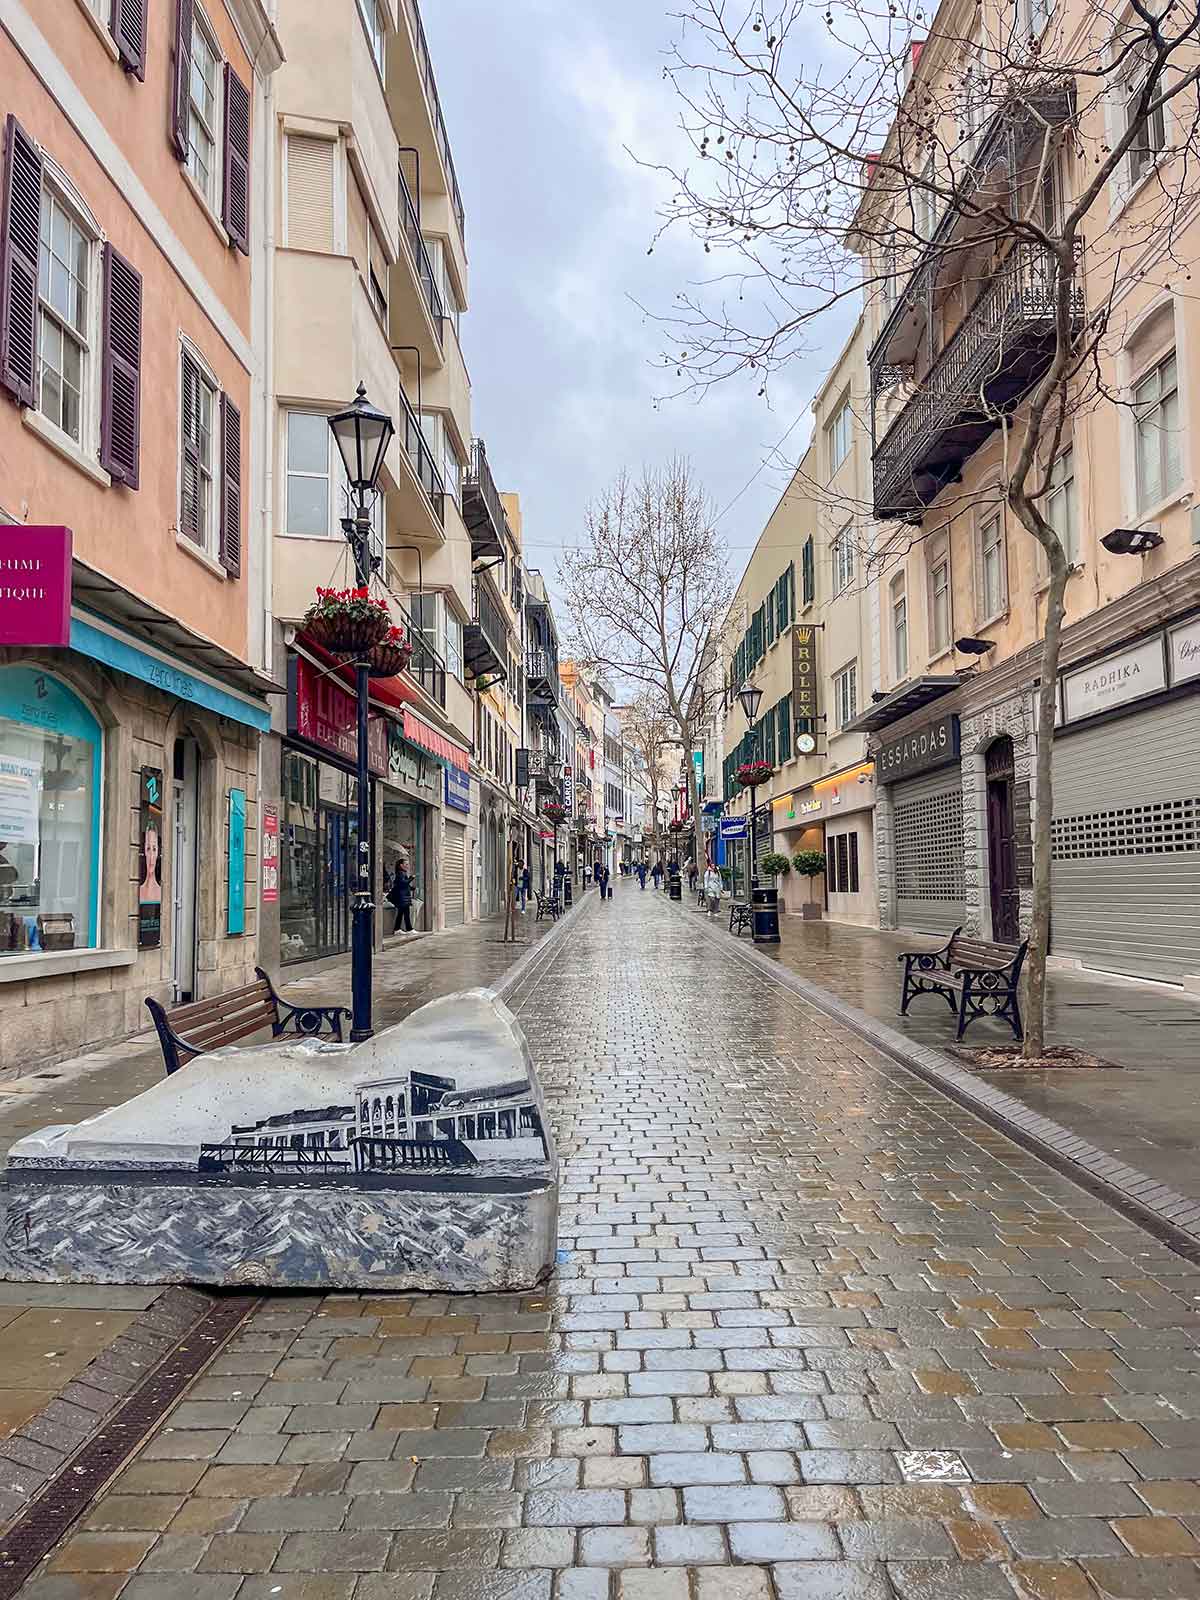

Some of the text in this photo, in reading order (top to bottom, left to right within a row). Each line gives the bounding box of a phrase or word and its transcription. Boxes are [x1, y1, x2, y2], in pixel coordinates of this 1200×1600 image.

[798, 647, 811, 717] ROLEX
[1084, 664, 1141, 694] RADHIKA
[564, 775, 572, 806] CARLOS
